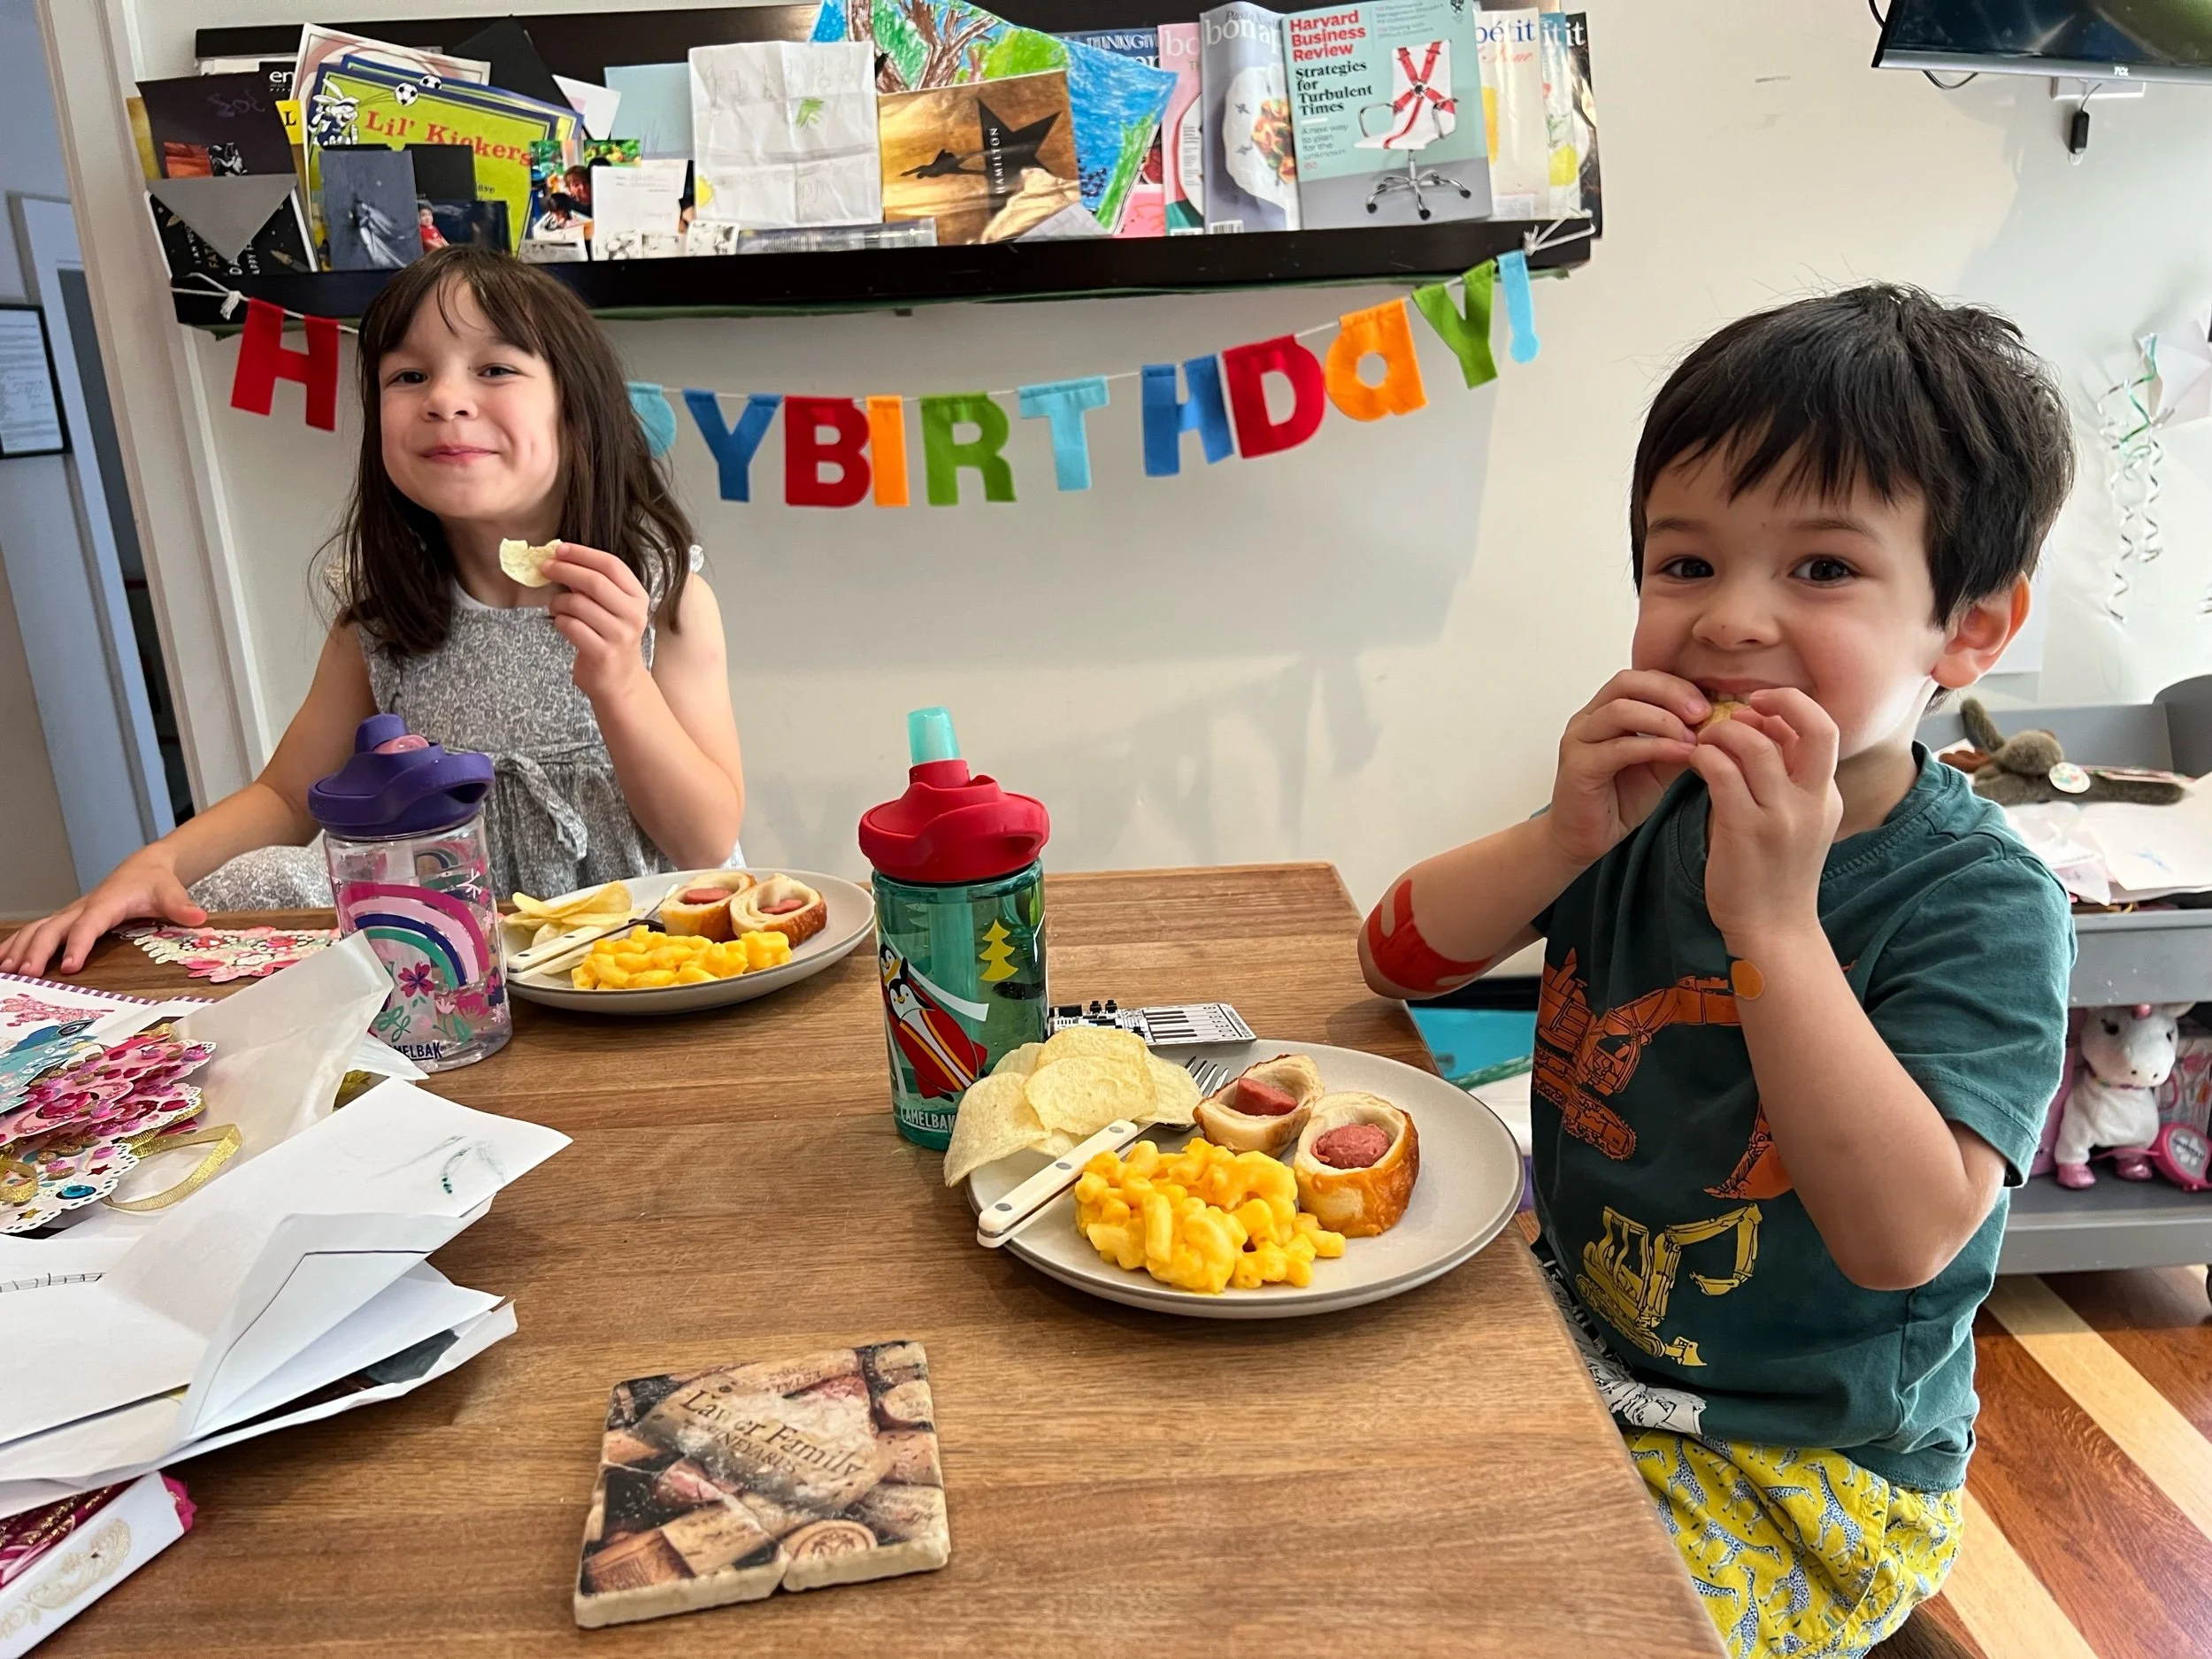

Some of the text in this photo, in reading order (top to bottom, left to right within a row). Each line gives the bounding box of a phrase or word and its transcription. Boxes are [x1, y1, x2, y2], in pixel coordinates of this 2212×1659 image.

[1289, 10, 1359, 33] Harvard
[1204, 19, 1257, 47] bon
[1291, 27, 1366, 48] Business
[1293, 43, 1354, 63] Review
[1295, 61, 1367, 79] Strategies
[1297, 80, 1319, 91] for
[1298, 85, 1373, 104] Turbulent
[1301, 102, 1345, 117] Times
[365, 110, 417, 136] Lil'
[989, 127, 1006, 194] HAMILTON
[389, 1042, 442, 1060] MELBAK
[900, 1105, 956, 1133] CAMELBAK
[764, 1424, 864, 1477] Family
